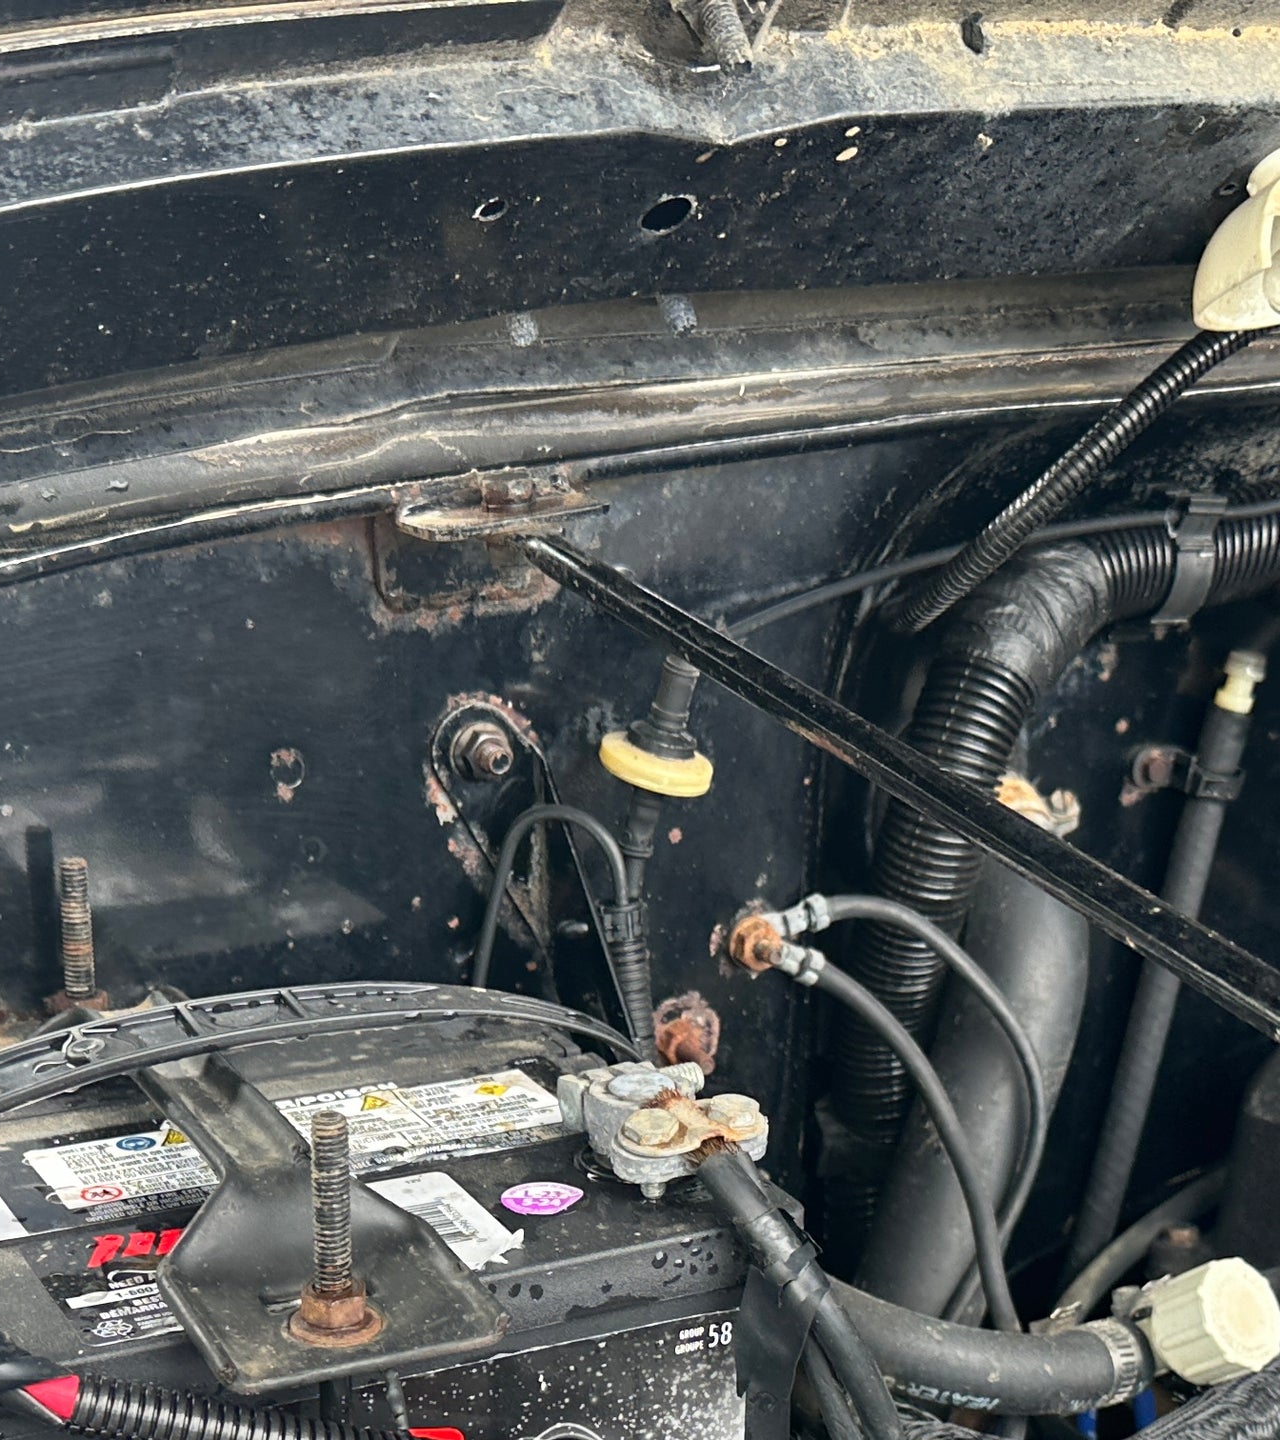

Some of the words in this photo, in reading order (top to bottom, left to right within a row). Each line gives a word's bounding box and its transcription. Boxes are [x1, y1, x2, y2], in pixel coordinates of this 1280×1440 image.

[108, 1275, 145, 1291] NEED
[679, 1327, 704, 1340] GROUP
[707, 1321, 733, 1348] 58
[675, 1341, 704, 1355] GROUPE
